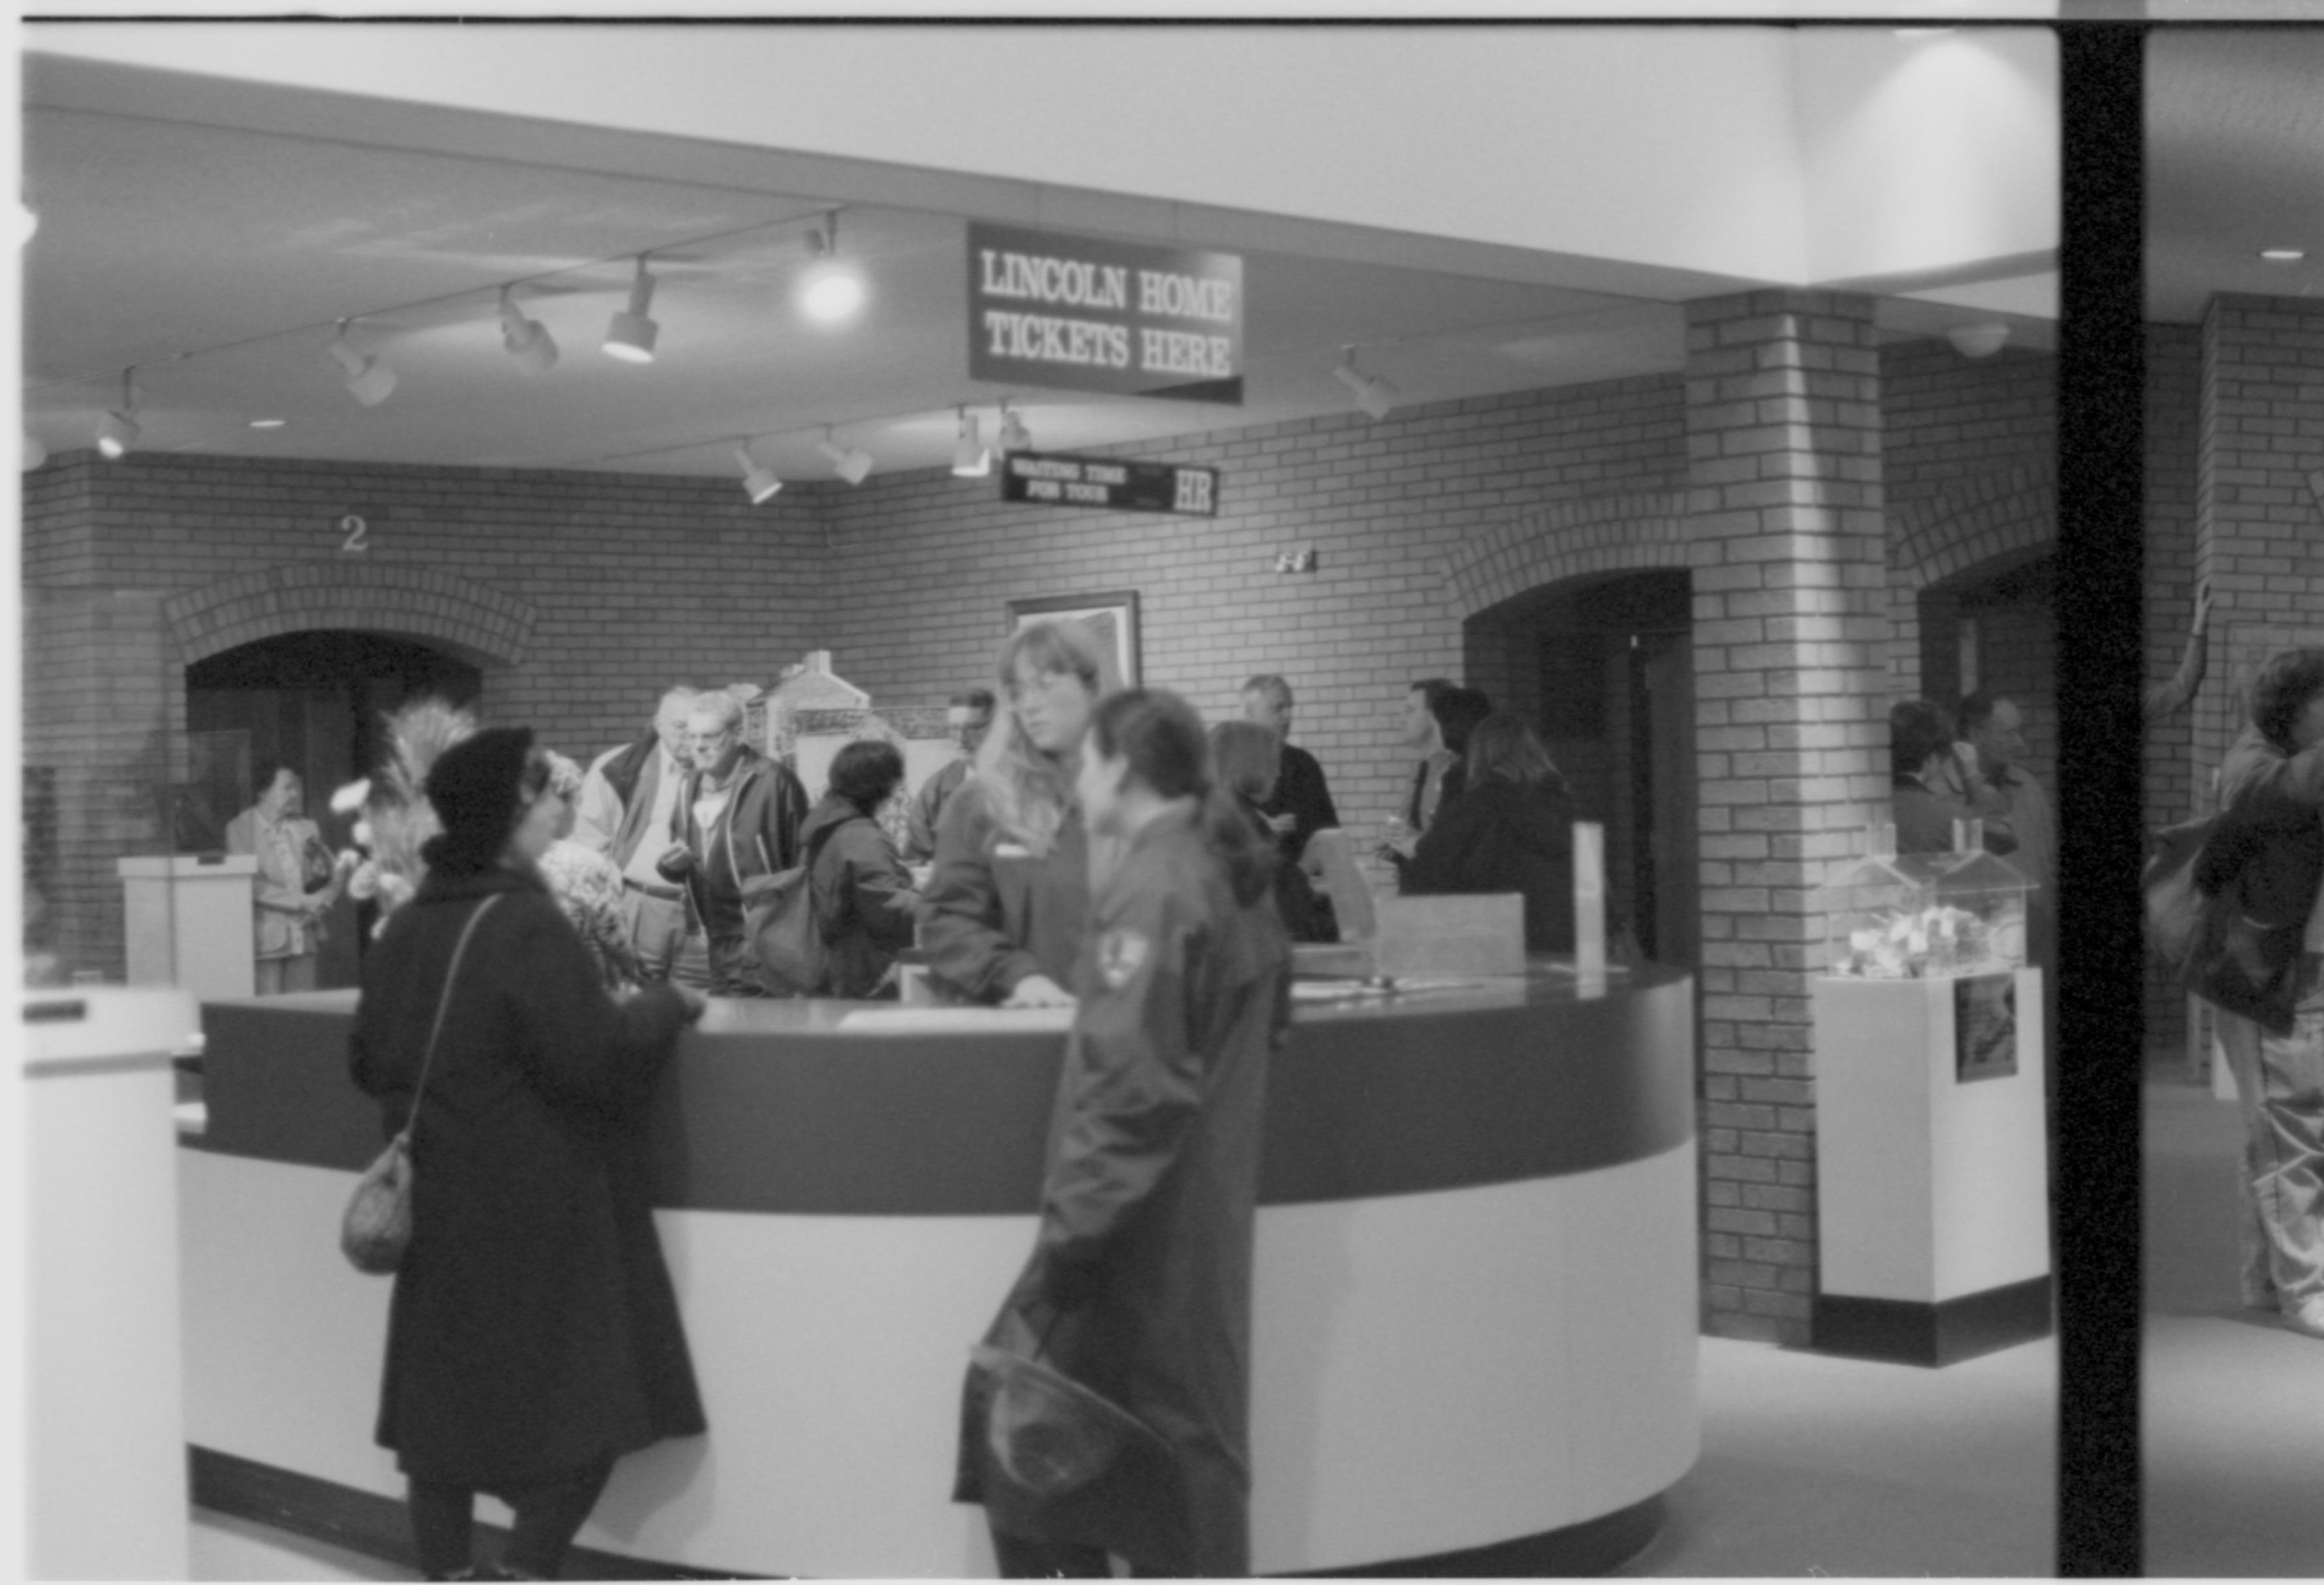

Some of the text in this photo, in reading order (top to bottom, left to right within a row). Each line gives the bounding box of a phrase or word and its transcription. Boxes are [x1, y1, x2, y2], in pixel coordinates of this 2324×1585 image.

[981, 249, 1233, 322] LINCOLN HOME
[985, 310, 1232, 379] TICKETS HERE
[341, 515, 368, 551] 2
